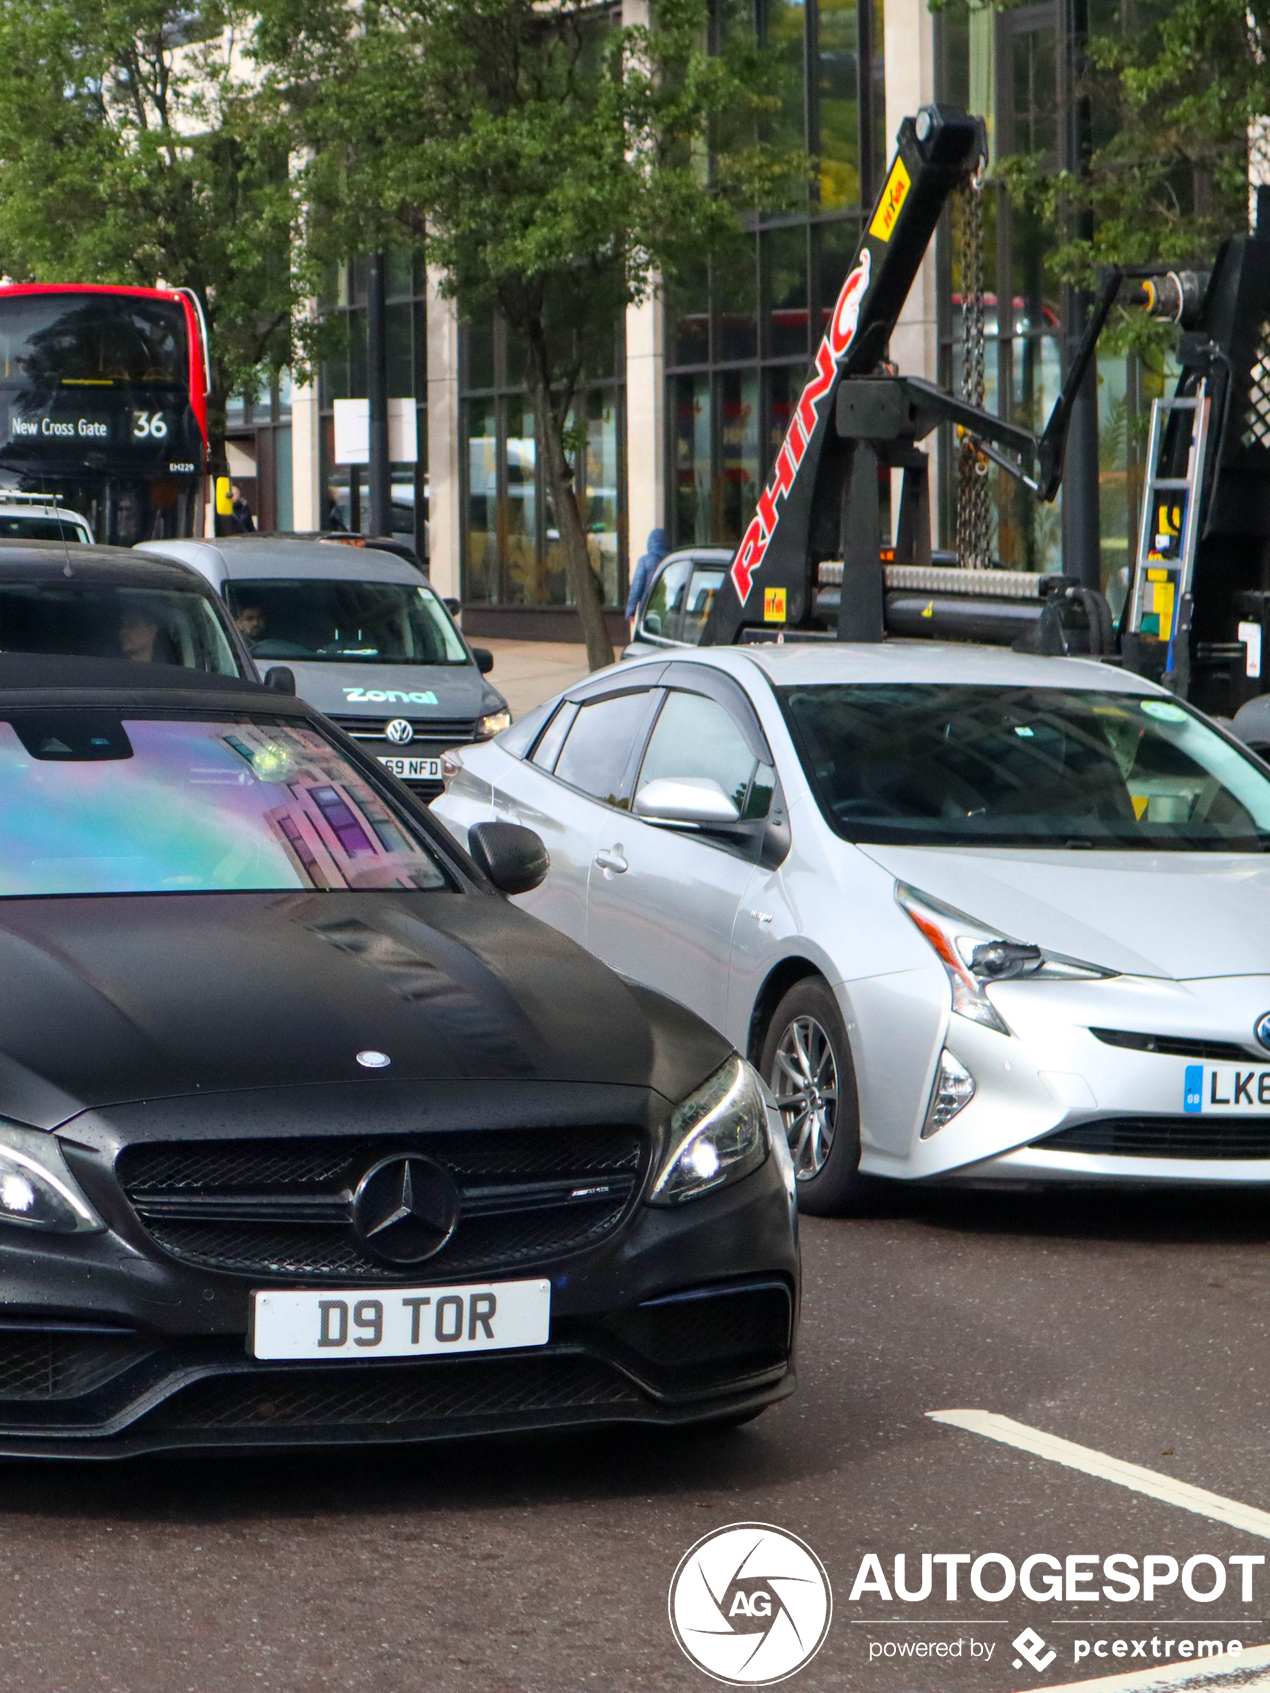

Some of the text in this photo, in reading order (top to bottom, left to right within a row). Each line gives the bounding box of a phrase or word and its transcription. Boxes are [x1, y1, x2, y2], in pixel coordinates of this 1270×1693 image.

[883, 180, 905, 230] HYVA
[12, 411, 168, 438] New Cross Gate 36
[169, 463, 195, 472] EH229
[409, 760, 438, 776] NFD
[1187, 1094, 1200, 1104] GB
[317, 1292, 497, 1348] D9 TOR
